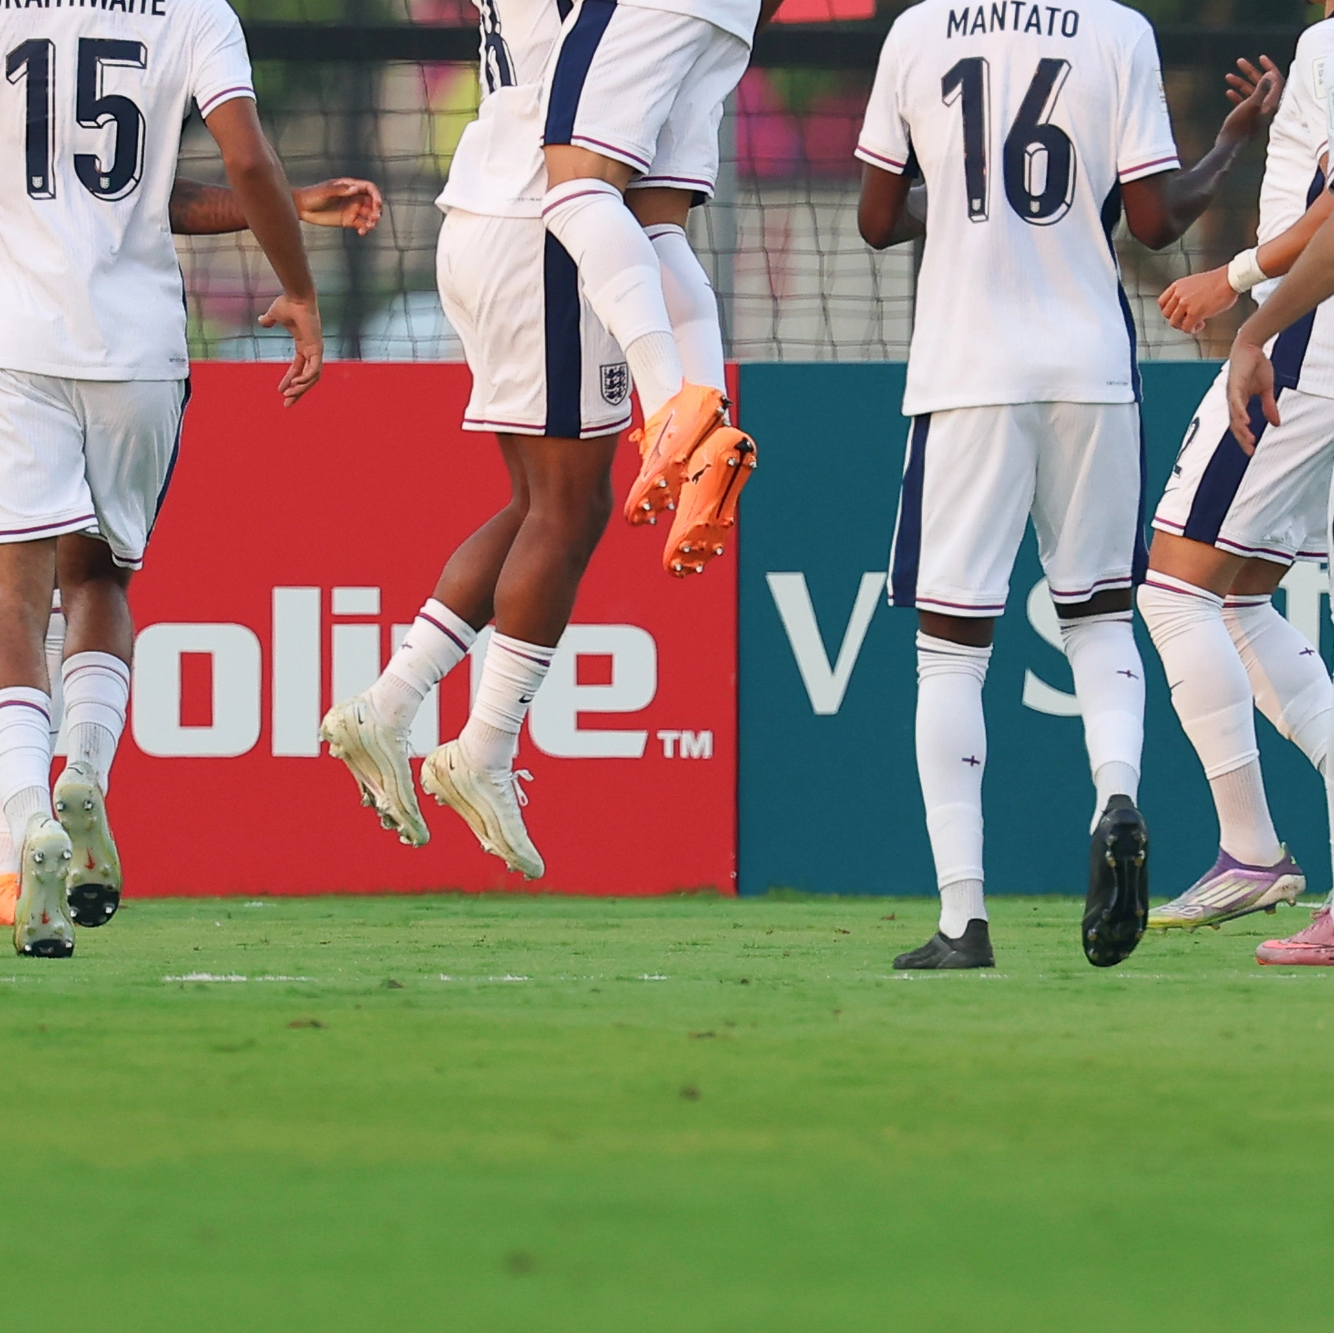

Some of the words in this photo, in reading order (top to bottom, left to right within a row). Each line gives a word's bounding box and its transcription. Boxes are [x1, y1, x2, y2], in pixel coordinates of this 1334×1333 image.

[946, 0, 1080, 39] MANTATO
[5, 37, 148, 202] 15
[941, 56, 1077, 227] 16
[658, 729, 714, 759] TM
